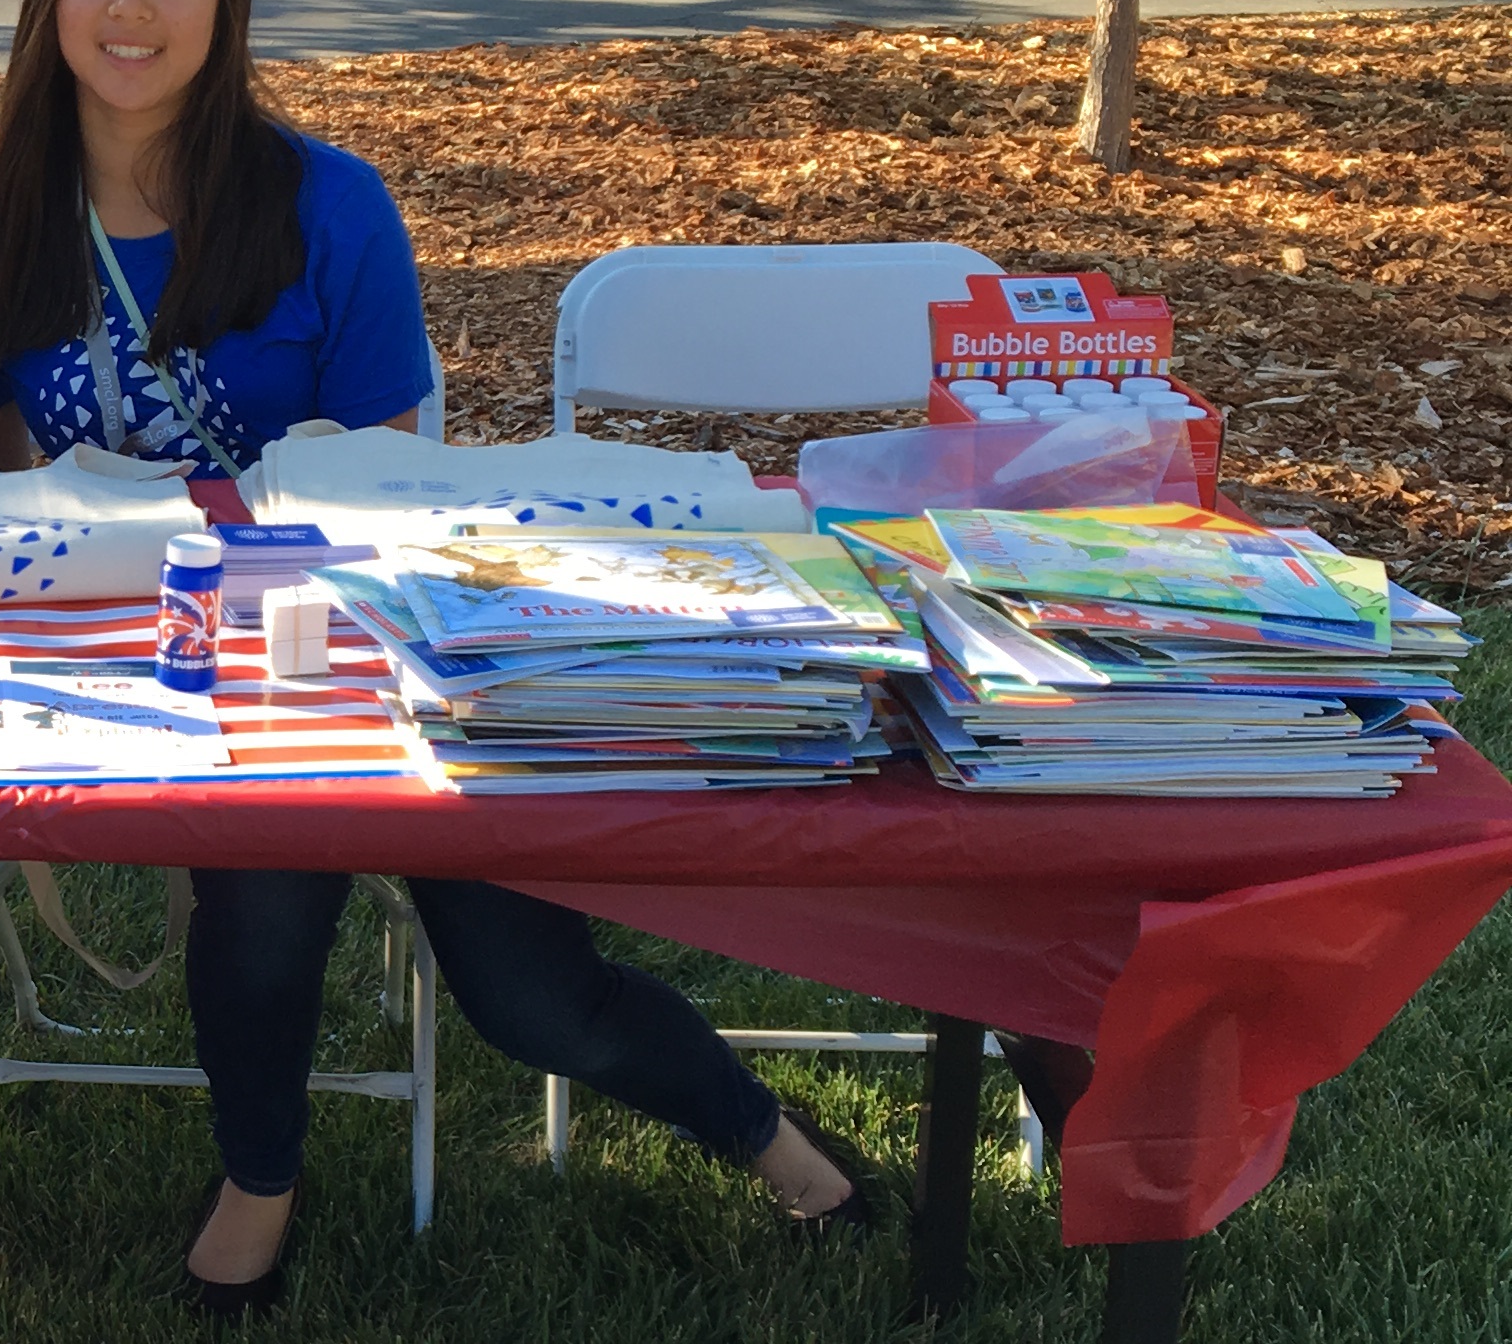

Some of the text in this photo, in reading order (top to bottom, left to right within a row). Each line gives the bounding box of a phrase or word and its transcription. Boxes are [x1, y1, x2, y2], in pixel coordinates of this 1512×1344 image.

[952, 329, 1157, 356] Bubble Bottles
[99, 367, 119, 431] smcl.org
[509, 603, 594, 618] The
[172, 658, 215, 670] BUBBLES
